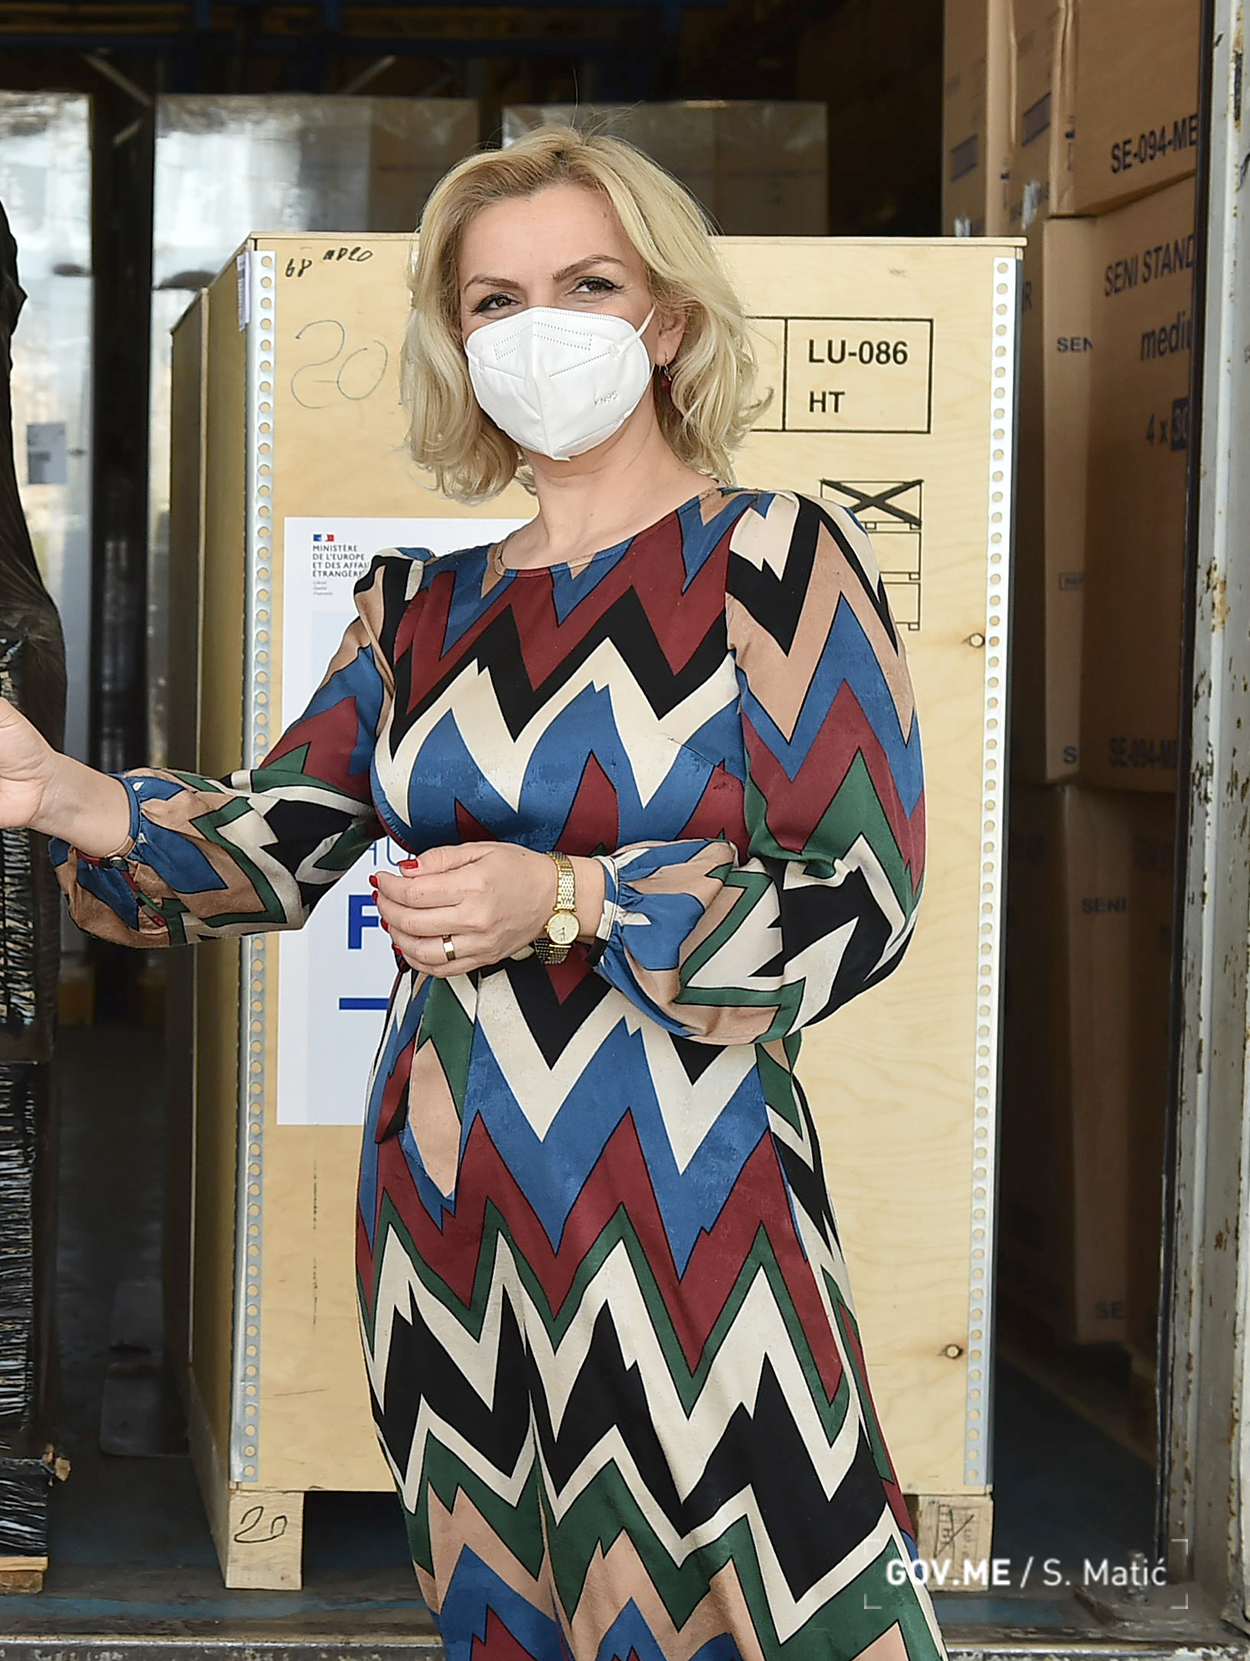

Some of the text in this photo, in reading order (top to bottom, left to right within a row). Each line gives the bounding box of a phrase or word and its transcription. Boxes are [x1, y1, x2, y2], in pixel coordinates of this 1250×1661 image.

[1105, 254, 1139, 297] SENI
[290, 319, 389, 409] 20
[808, 338, 909, 366] LU-086
[809, 390, 846, 413] HT
[312, 544, 358, 552] MINISTÈRE
[312, 553, 365, 561] DE L'EUROPE
[234, 1505, 288, 1544] 20
